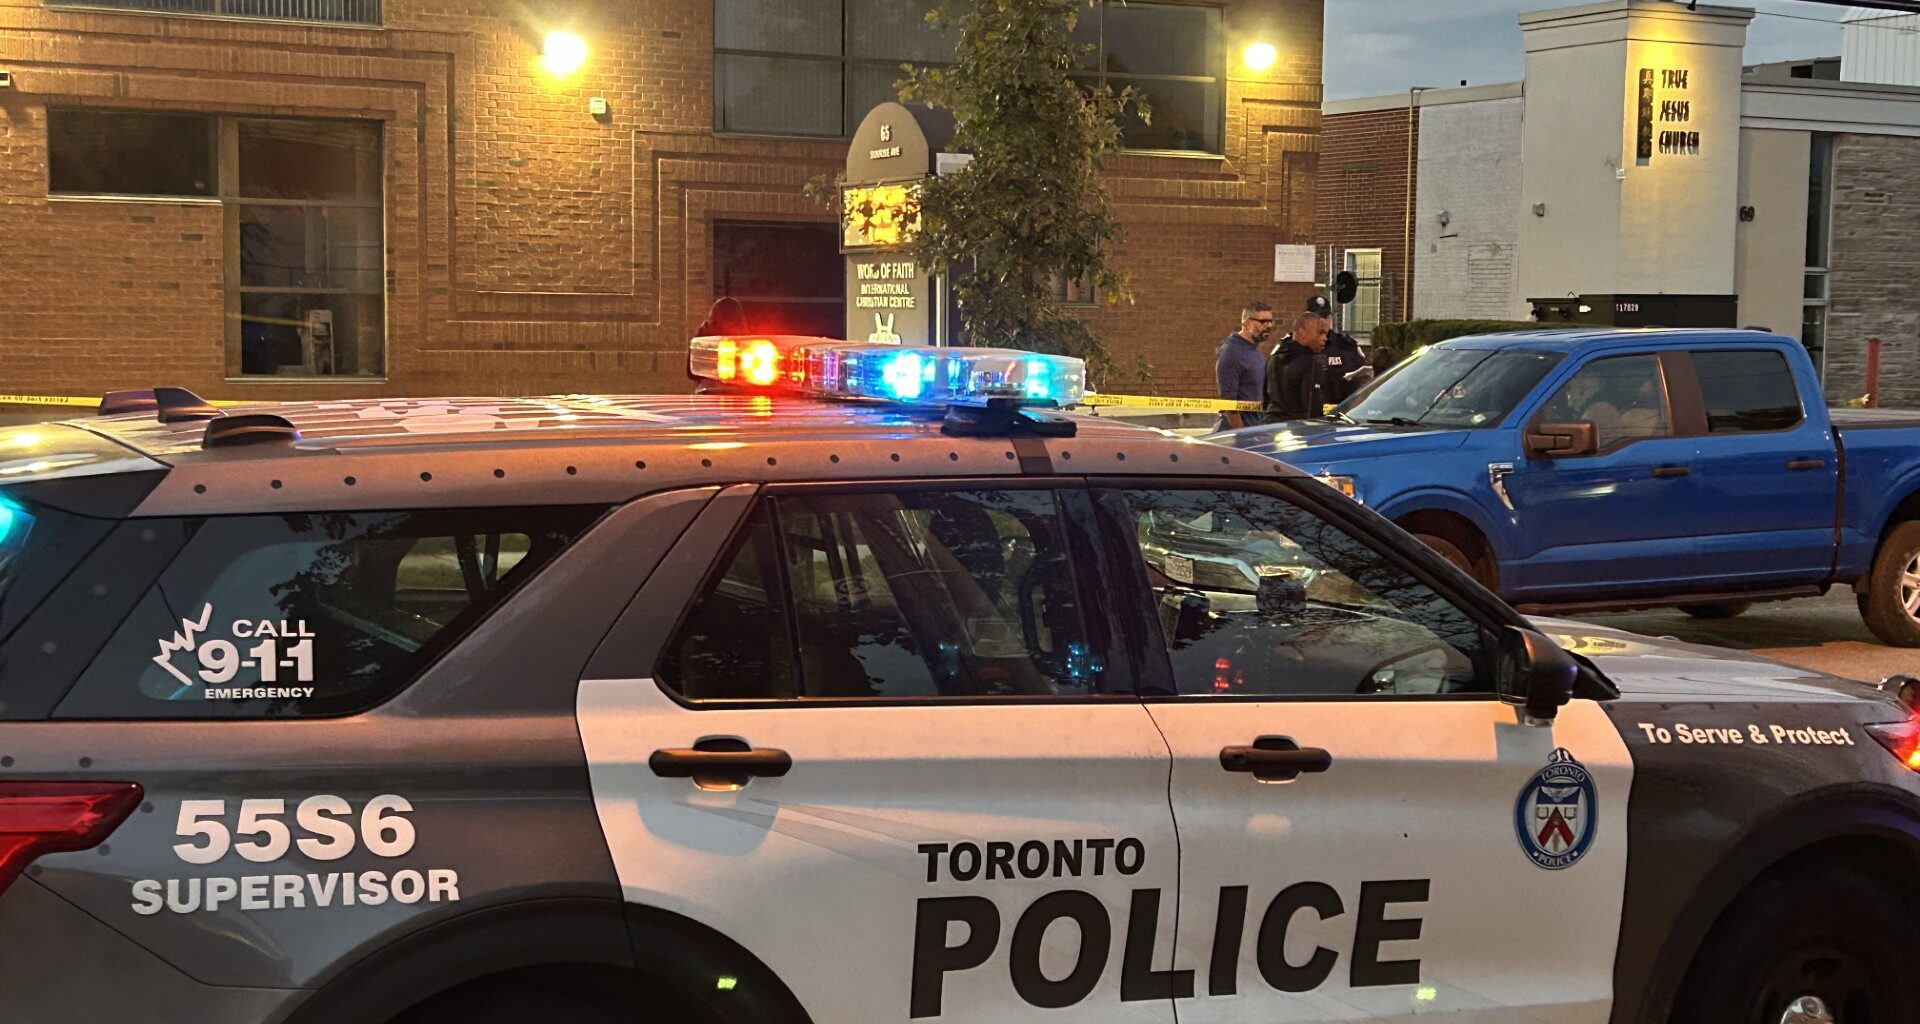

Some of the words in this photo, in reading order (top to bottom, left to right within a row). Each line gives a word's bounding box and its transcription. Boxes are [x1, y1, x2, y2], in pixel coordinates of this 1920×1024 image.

[1661, 69, 1688, 90] TRUE
[1660, 100, 1690, 122] JESUS
[1659, 130, 1700, 155] CHURCH
[880, 262, 892, 280] OF
[892, 262, 915, 279] FAITH
[860, 283, 910, 295] INTERNATIONAL
[856, 296, 889, 308] CHRISTIAN
[889, 296, 915, 308] CENTRE
[232, 619, 316, 638] CALL
[197, 639, 314, 684] 9-1-1
[204, 687, 315, 700] EMERGENCY
[1638, 723, 1671, 744] To
[1674, 723, 1744, 745] Serve
[1747, 724, 1768, 745] &
[1769, 724, 1855, 746] Protect
[1540, 764, 1586, 783] TORONTO
[172, 794, 416, 865] 55S6
[917, 836, 1146, 883] TORONTO
[1537, 854, 1572, 868] POLICE
[131, 868, 460, 916] SUPERVISOR
[909, 878, 1431, 1020] POLICE
